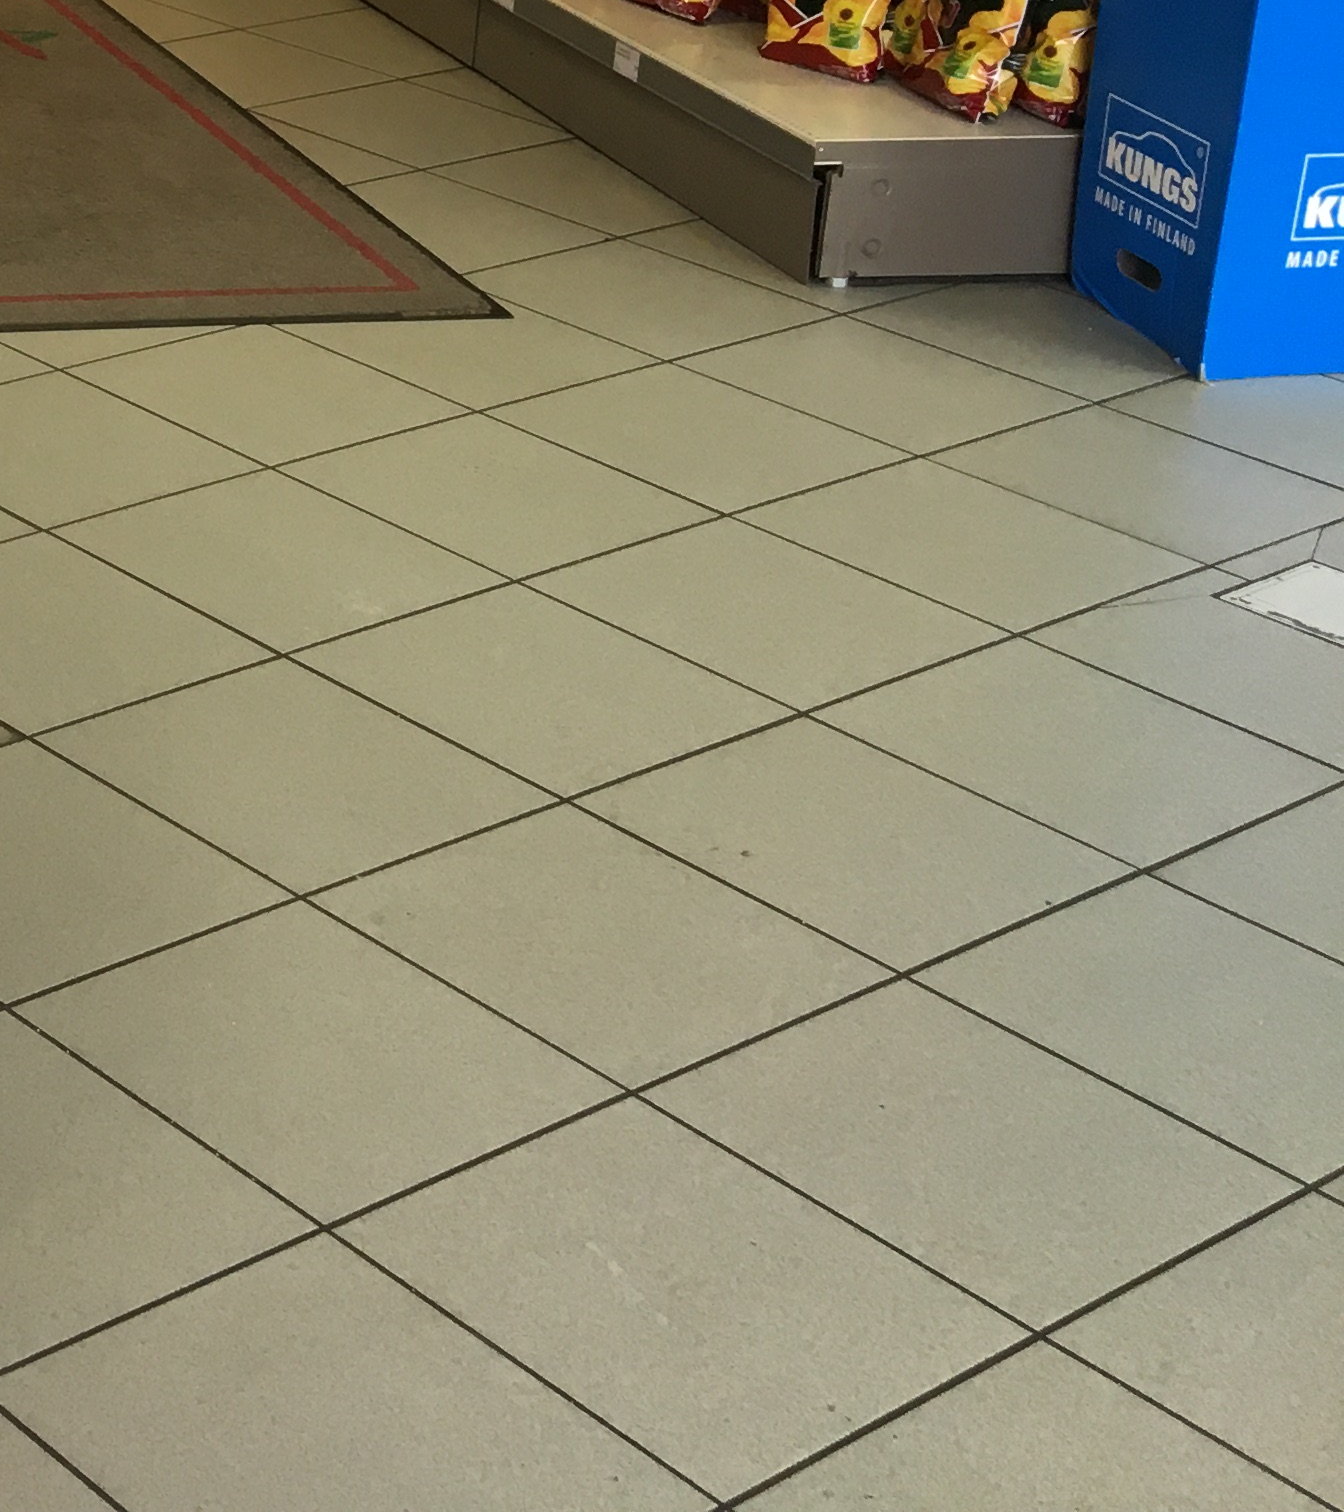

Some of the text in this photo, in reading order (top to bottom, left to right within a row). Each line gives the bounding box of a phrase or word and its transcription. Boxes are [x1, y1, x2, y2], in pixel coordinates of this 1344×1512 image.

[1105, 136, 1198, 213] KUNGS
[1094, 186, 1196, 256] MADE IN FINLAND
[1285, 250, 1340, 269] MADE
